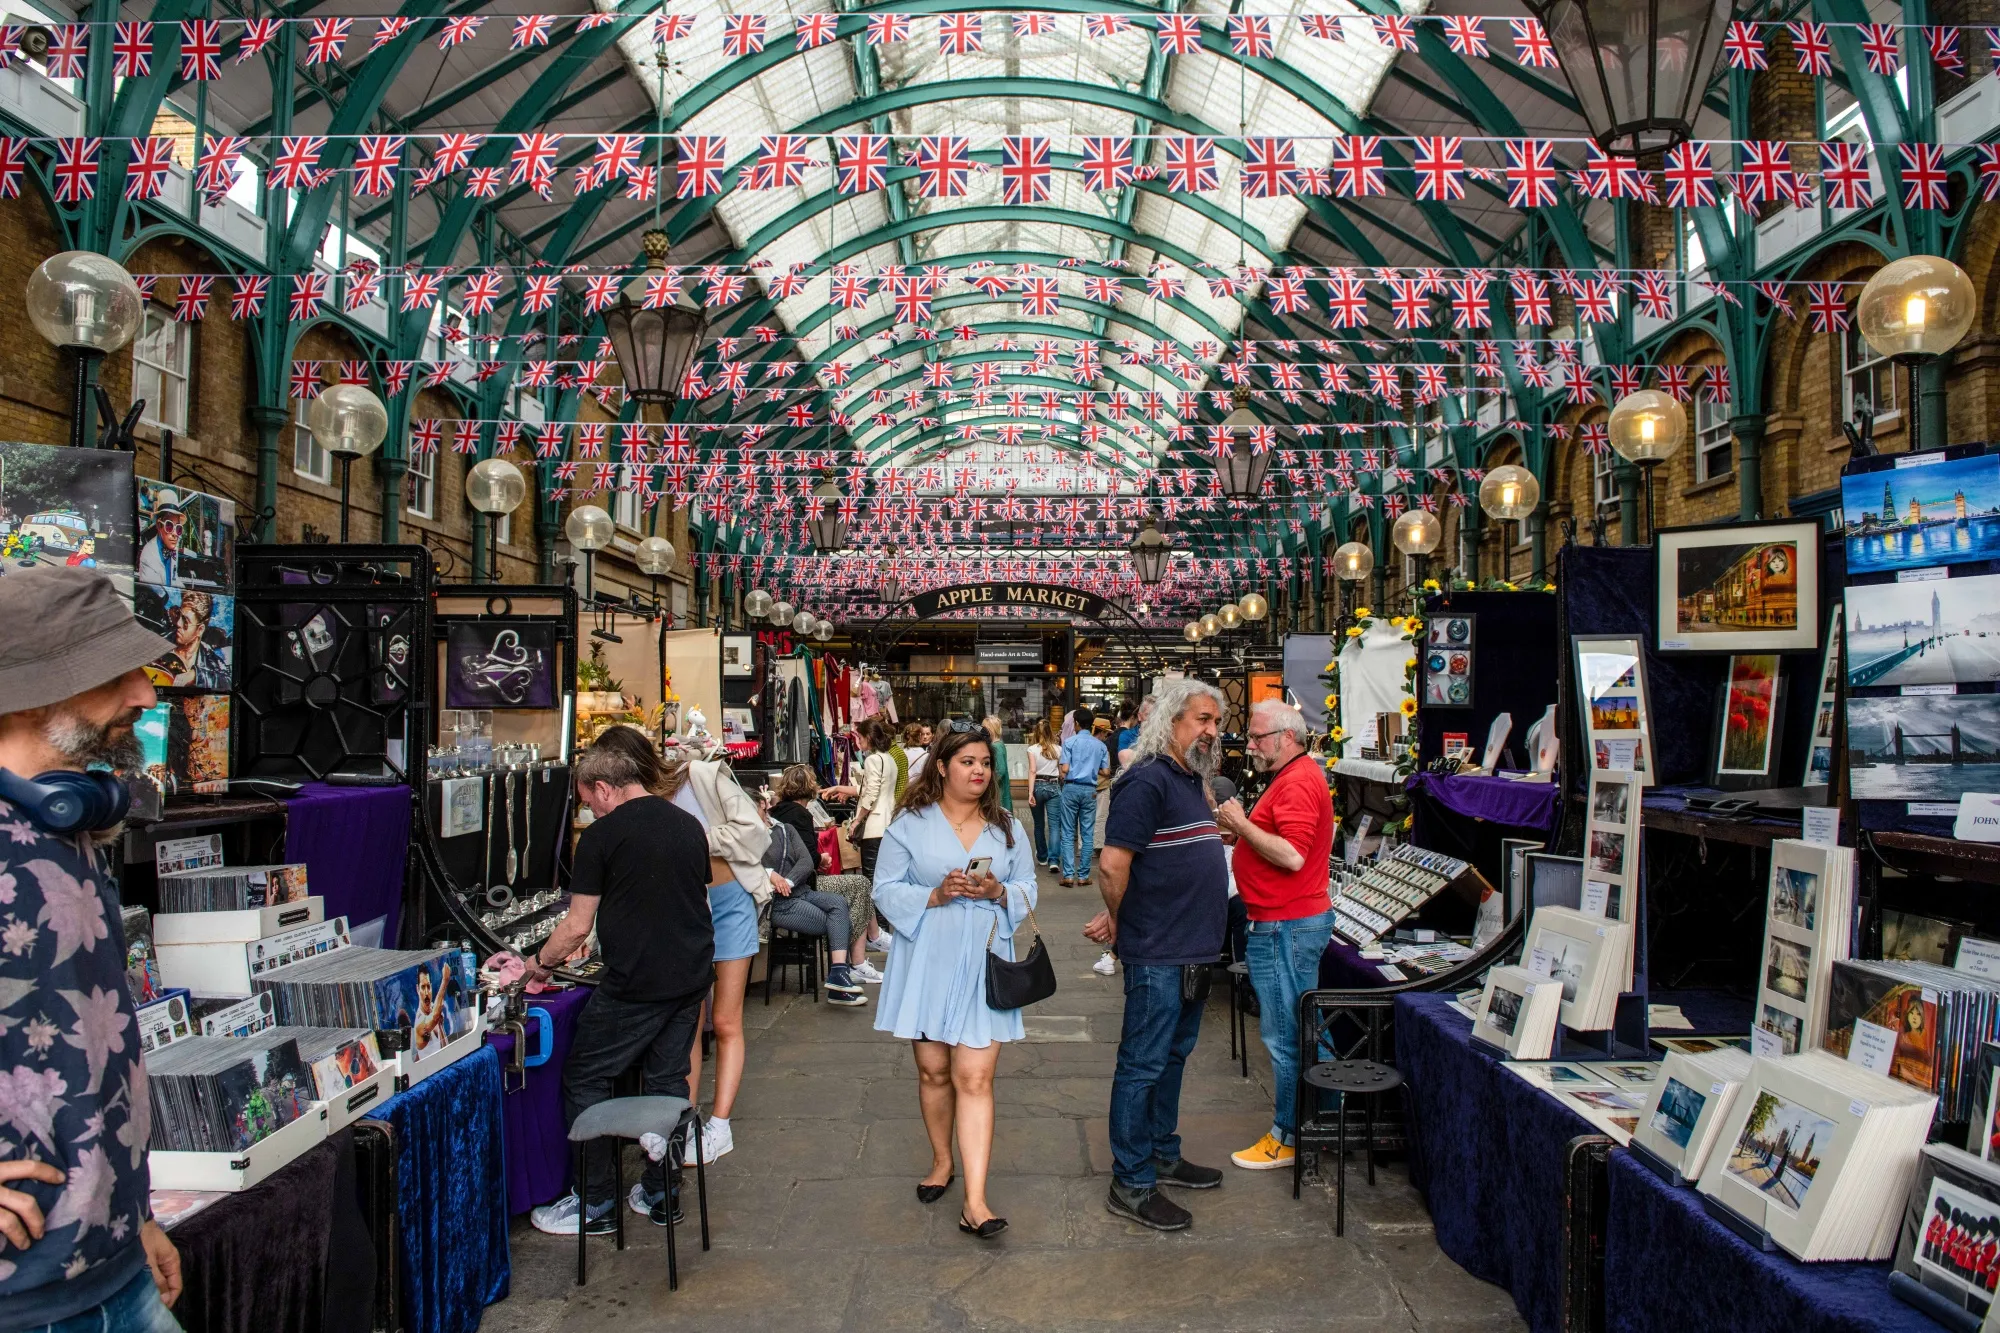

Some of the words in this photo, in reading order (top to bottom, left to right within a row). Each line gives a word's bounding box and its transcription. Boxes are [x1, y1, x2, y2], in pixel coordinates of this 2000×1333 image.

[937, 587, 993, 609] APPLE
[1007, 586, 1090, 611] MARKET
[1973, 815, 1999, 826] JOHN
[153, 1021, 164, 1032] £20
